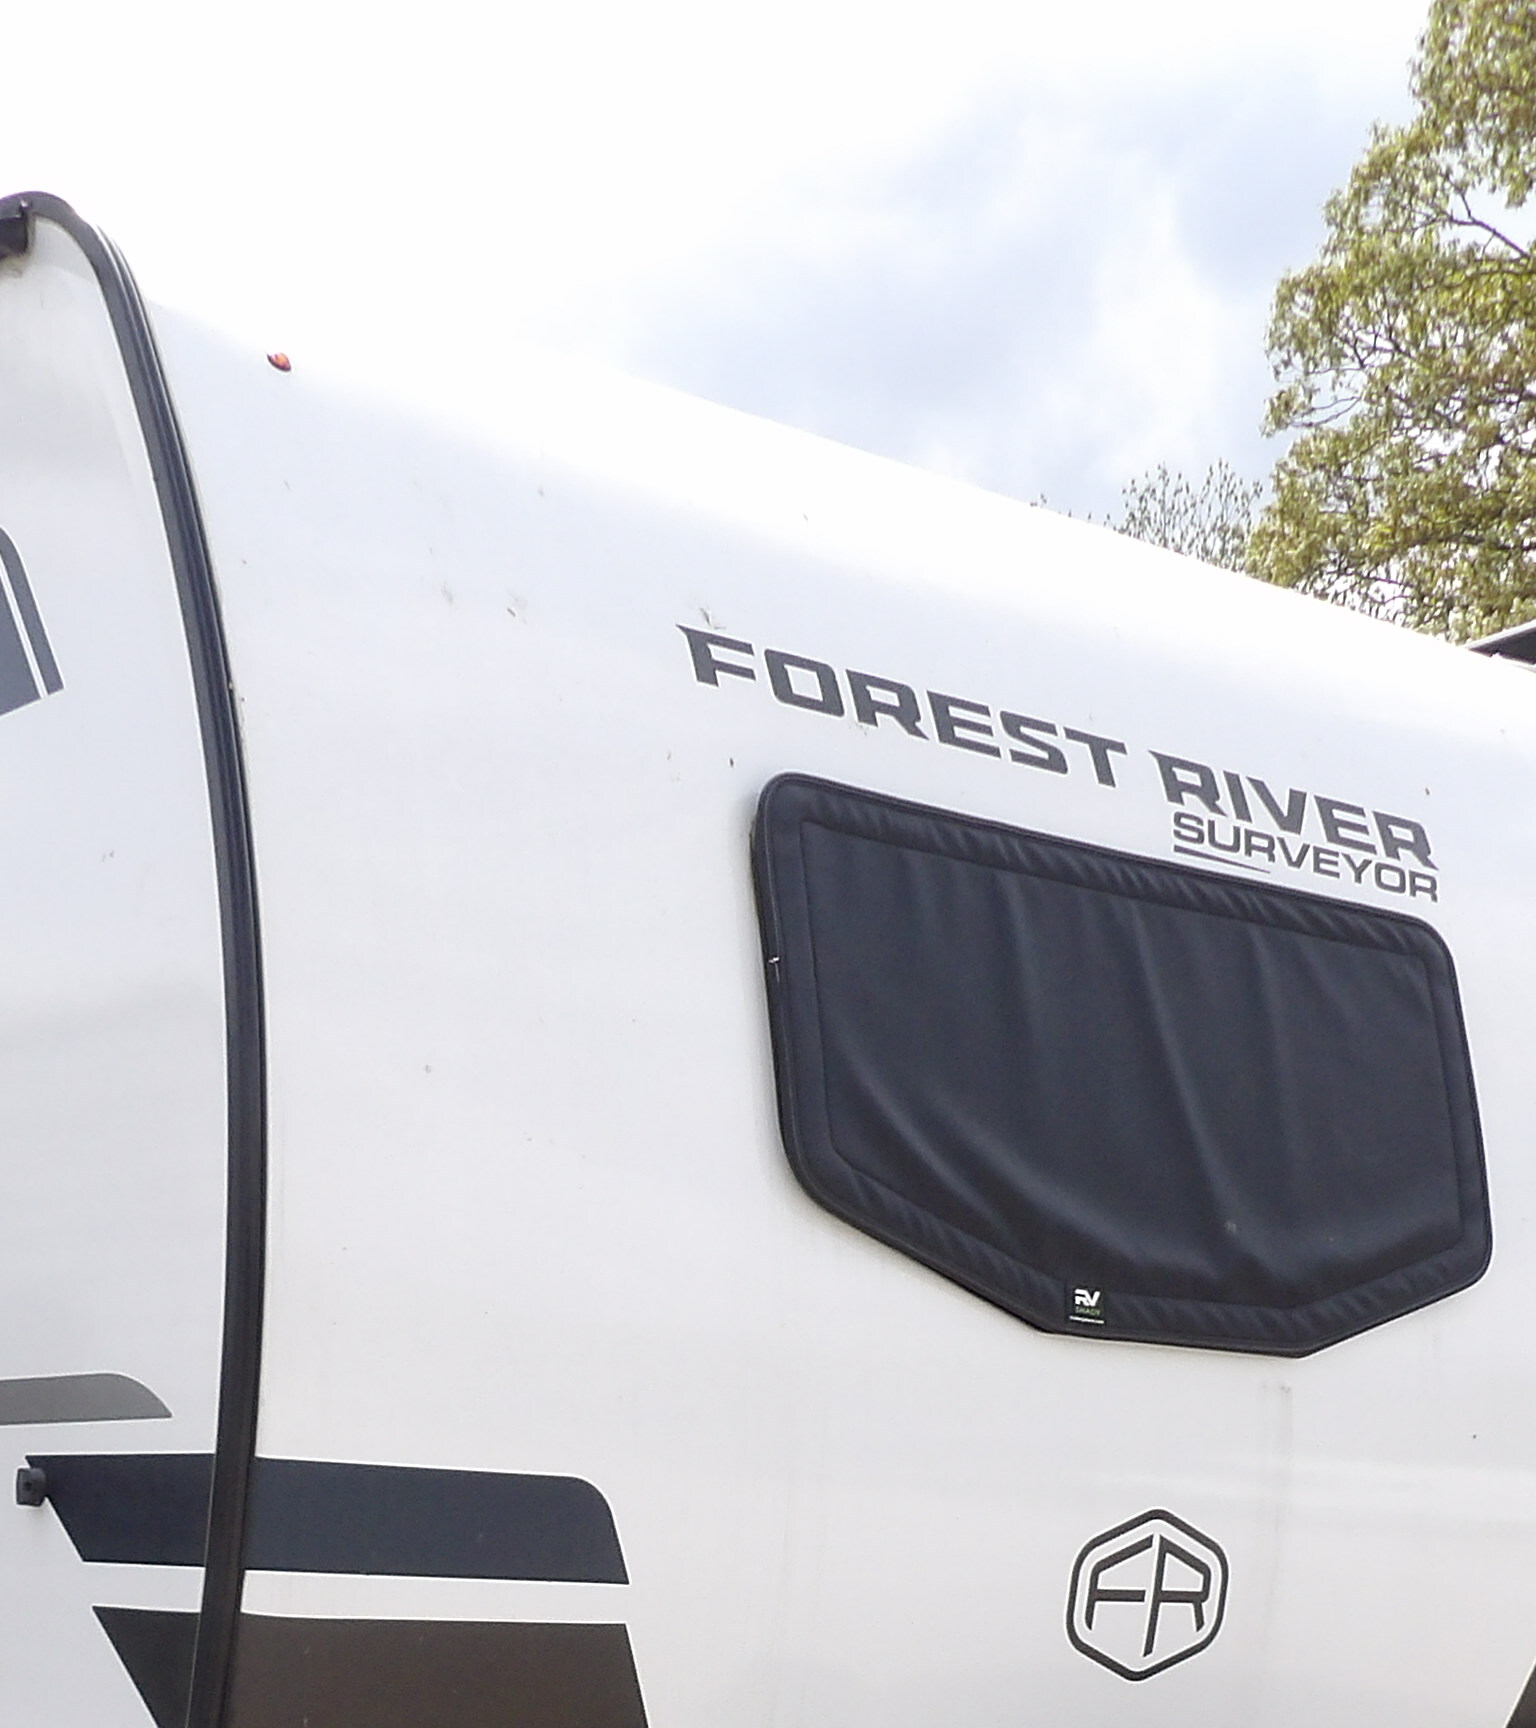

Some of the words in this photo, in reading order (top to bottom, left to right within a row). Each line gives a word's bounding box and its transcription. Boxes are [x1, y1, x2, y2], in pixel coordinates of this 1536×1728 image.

[676, 624, 1128, 788] FOREST
[1148, 750, 1440, 871] RIVER
[1173, 811, 1439, 903] SURVEYOR
[1074, 1288, 1101, 1307] RV
